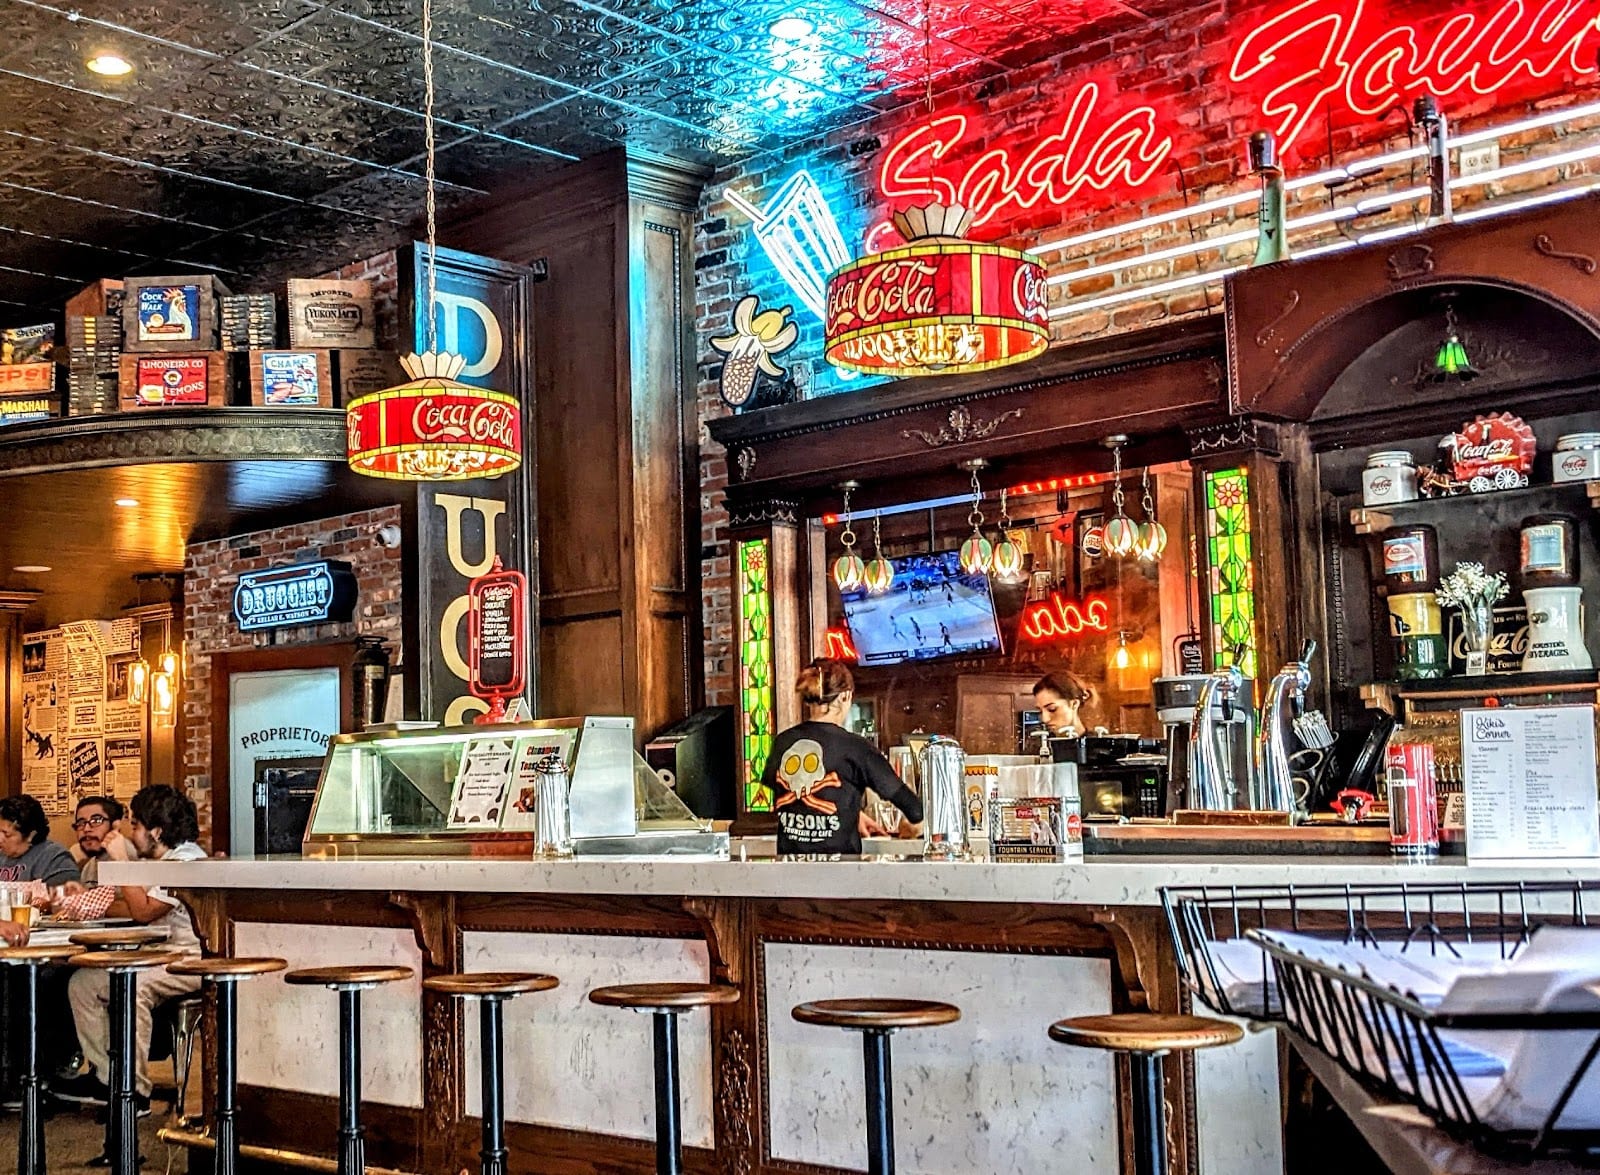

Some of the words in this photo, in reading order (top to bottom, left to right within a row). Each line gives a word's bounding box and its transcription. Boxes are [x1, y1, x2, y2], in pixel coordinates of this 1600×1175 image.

[867, 82, 1172, 250] Soda
[310, 289, 353, 298] IMPORTED
[141, 302, 163, 311] WALK
[308, 307, 338, 319] YUKON
[338, 308, 359, 319] JACK
[142, 360, 190, 368] LIMONEIRA
[191, 360, 203, 368] CO
[164, 382, 205, 396] LEMONS
[241, 577, 329, 615] DRUGGIST
[241, 727, 330, 749] PROPRIETOR
[1476, 729, 1511, 740] Corner
[778, 811, 840, 831] ATSON'S
[998, 846, 1028, 854] FOUNTAIN
[1029, 846, 1053, 854] SERVICE
